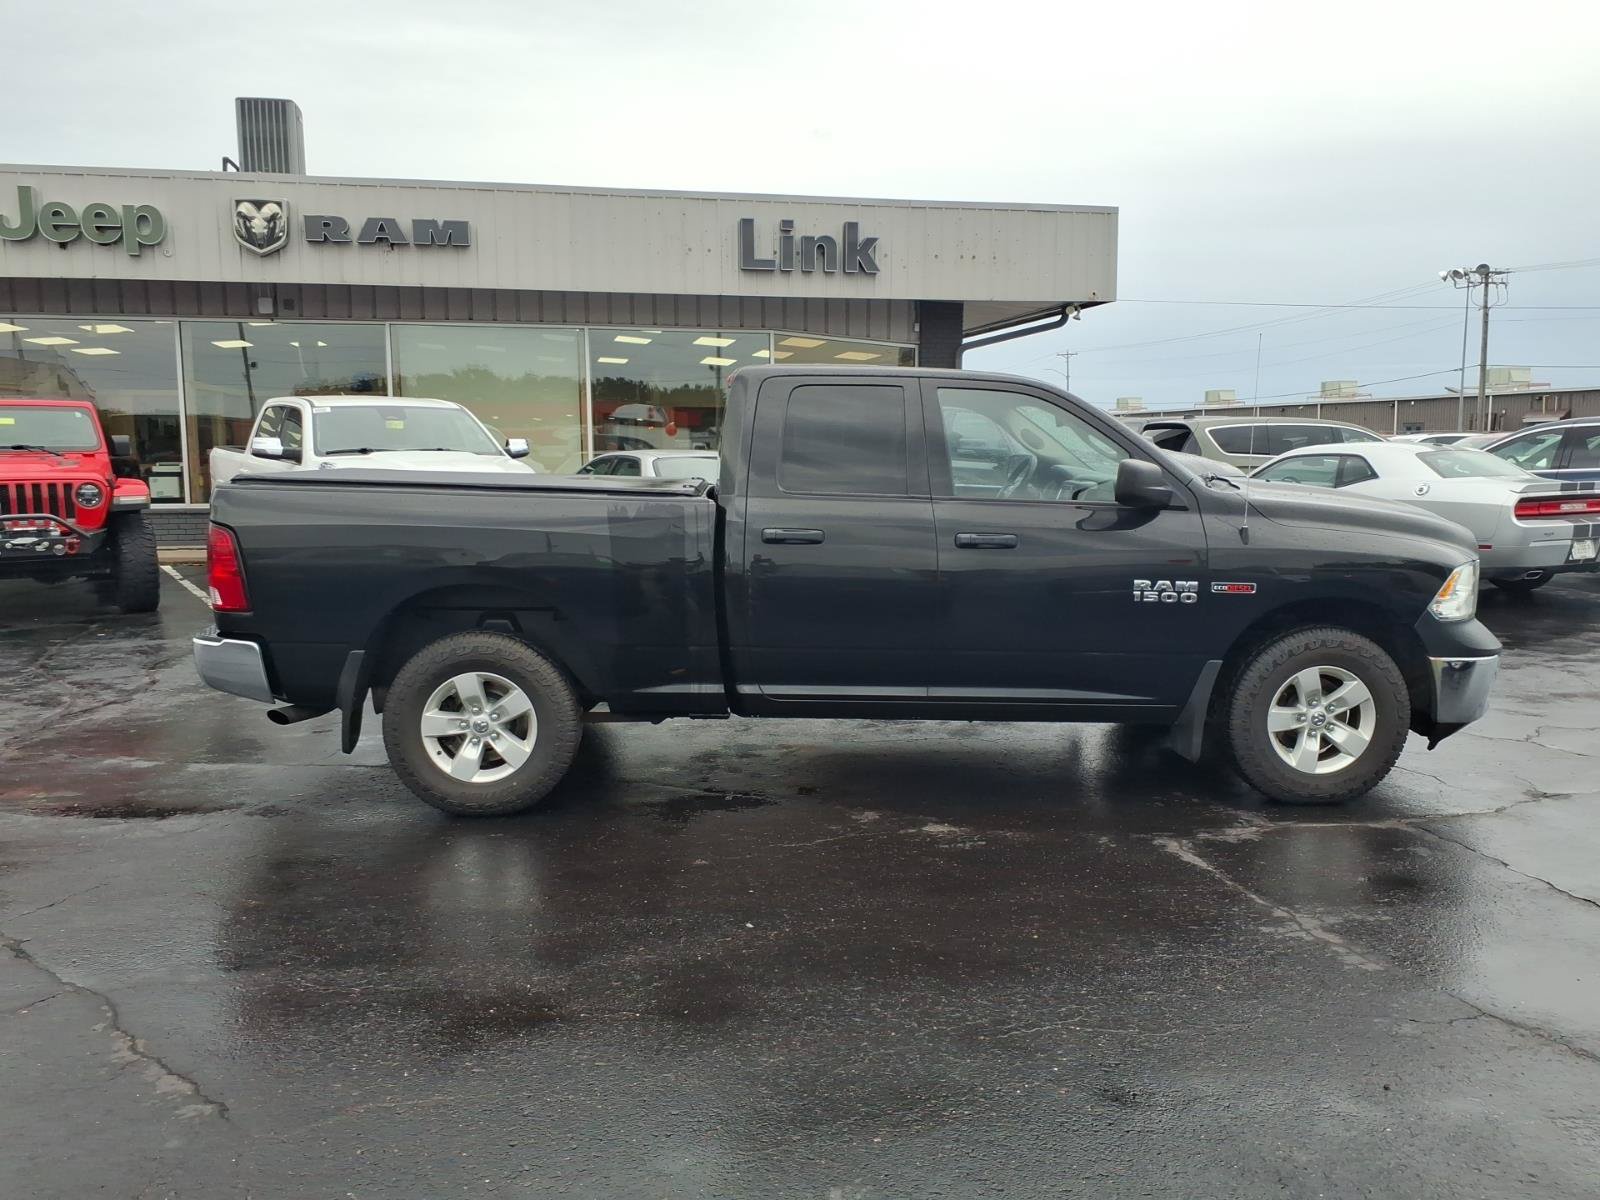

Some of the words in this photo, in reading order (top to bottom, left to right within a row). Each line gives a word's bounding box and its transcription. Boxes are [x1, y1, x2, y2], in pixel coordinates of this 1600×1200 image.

[0, 185, 167, 255] Jeep
[303, 214, 471, 247] RAM
[740, 218, 880, 273] Link
[1133, 579, 1199, 592] RAM
[1133, 591, 1198, 603] 1500
